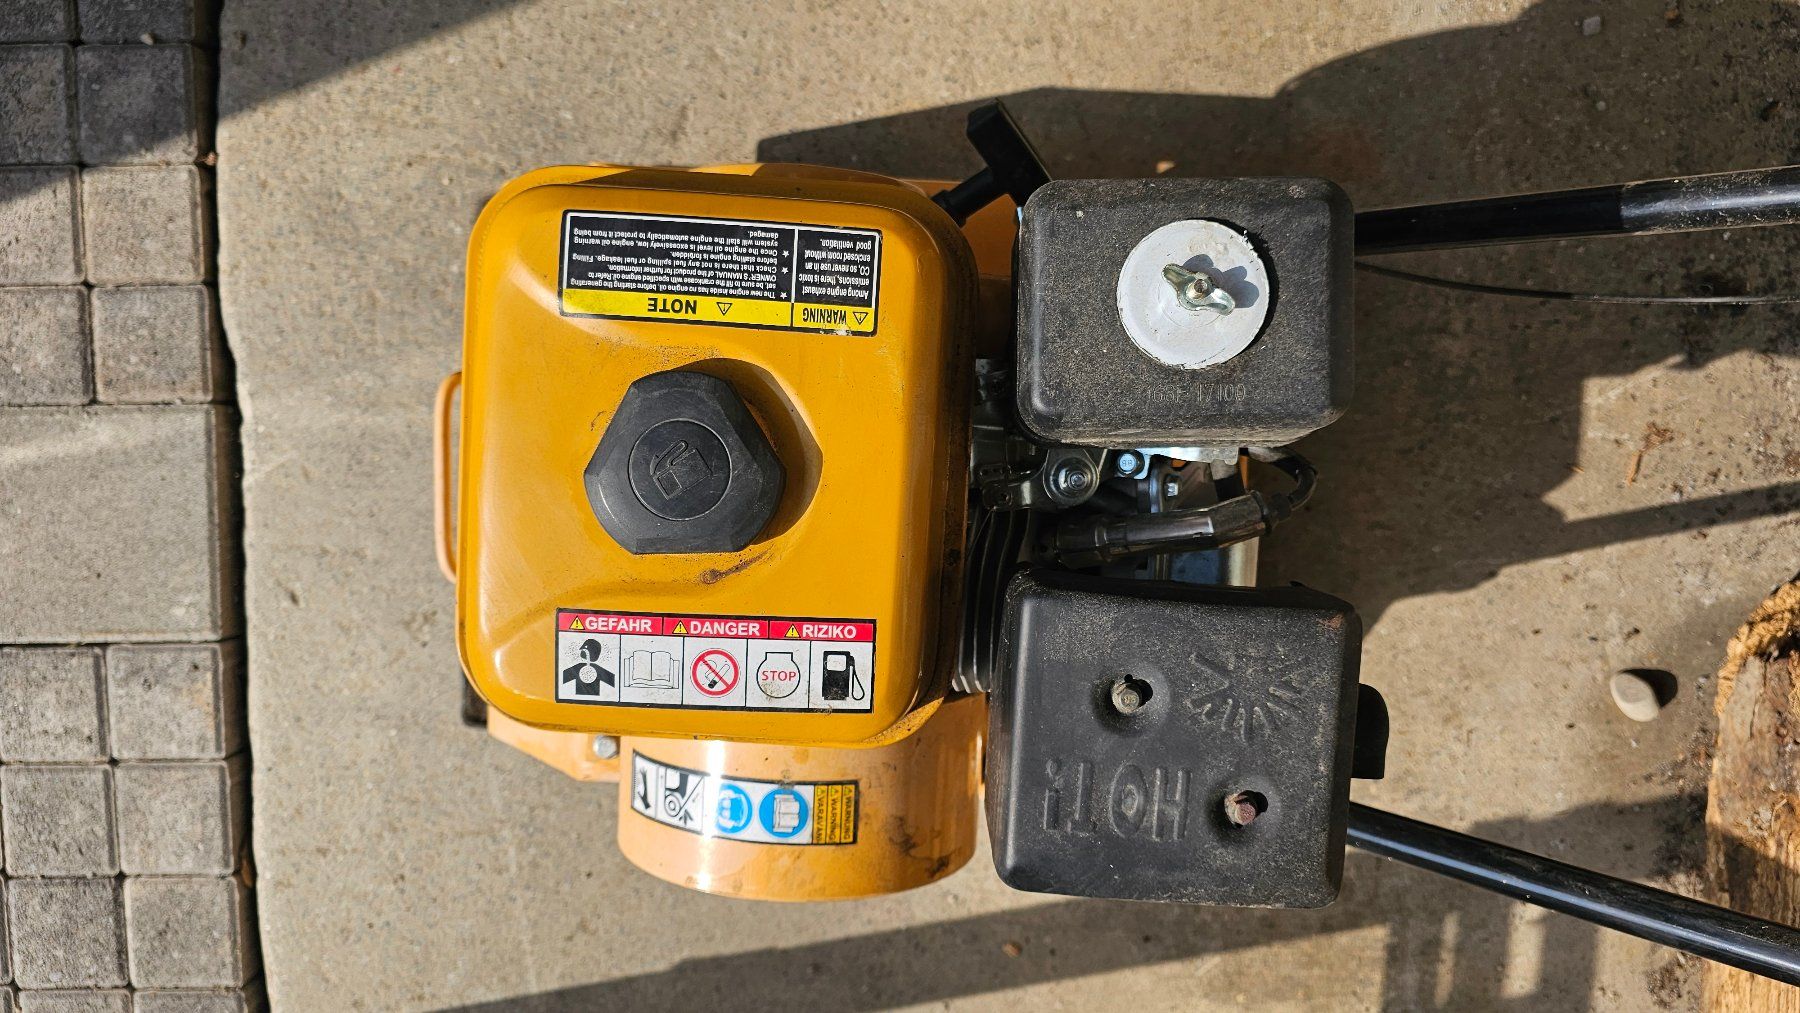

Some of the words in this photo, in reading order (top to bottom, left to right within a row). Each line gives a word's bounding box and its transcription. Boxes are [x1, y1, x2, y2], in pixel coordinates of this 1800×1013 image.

[573, 226, 592, 236] being
[592, 229, 607, 237] from
[614, 229, 638, 239] protect
[748, 229, 779, 240] damaged.
[574, 235, 601, 245] warning
[646, 231, 689, 242] automatically
[689, 234, 713, 244] engine
[611, 237, 634, 247] engine
[650, 240, 688, 251] excessively
[726, 238, 740, 246] stall
[754, 238, 778, 248] system
[820, 239, 853, 250] ventilation.
[856, 240, 872, 251] good
[724, 245, 747, 254] engine
[572, 252, 594, 261] Filling
[595, 253, 623, 263] leakage.
[670, 251, 702, 260] forbidden.
[710, 252, 732, 262] engine
[804, 250, 826, 260] without
[827, 251, 842, 259] room
[843, 252, 871, 263] enclosed
[647, 257, 672, 266] spilling
[688, 259, 700, 267] any
[756, 257, 777, 265] before
[607, 264, 642, 273] information.
[643, 266, 663, 274] further
[673, 267, 696, 276] product
[721, 263, 739, 271] there
[740, 264, 754, 272] that
[755, 265, 777, 273] Check
[832, 264, 849, 272] never
[858, 264, 870, 275] CO,
[621, 272, 641, 281] engine
[642, 273, 669, 283] specified
[715, 271, 742, 279] MANUAL
[799, 274, 813, 284] toxic
[814, 275, 820, 284] is
[820, 275, 836, 285] there
[570, 277, 602, 287] generating
[614, 280, 636, 289] starting
[684, 278, 714, 286] crankcase
[837, 274, 869, 287] emissions,
[637, 283, 656, 291] before
[668, 284, 688, 293] engine
[802, 286, 826, 296] exhaust
[827, 286, 847, 298] engine
[729, 288, 749, 297] engine
[848, 287, 869, 299] Among
[647, 297, 697, 315] NOTE
[802, 308, 847, 325] WARNING
[585, 616, 653, 633] GEFAHR
[690, 620, 760, 637] DANGER
[802, 625, 857, 639] RIZIKO
[761, 670, 797, 682] STOP
